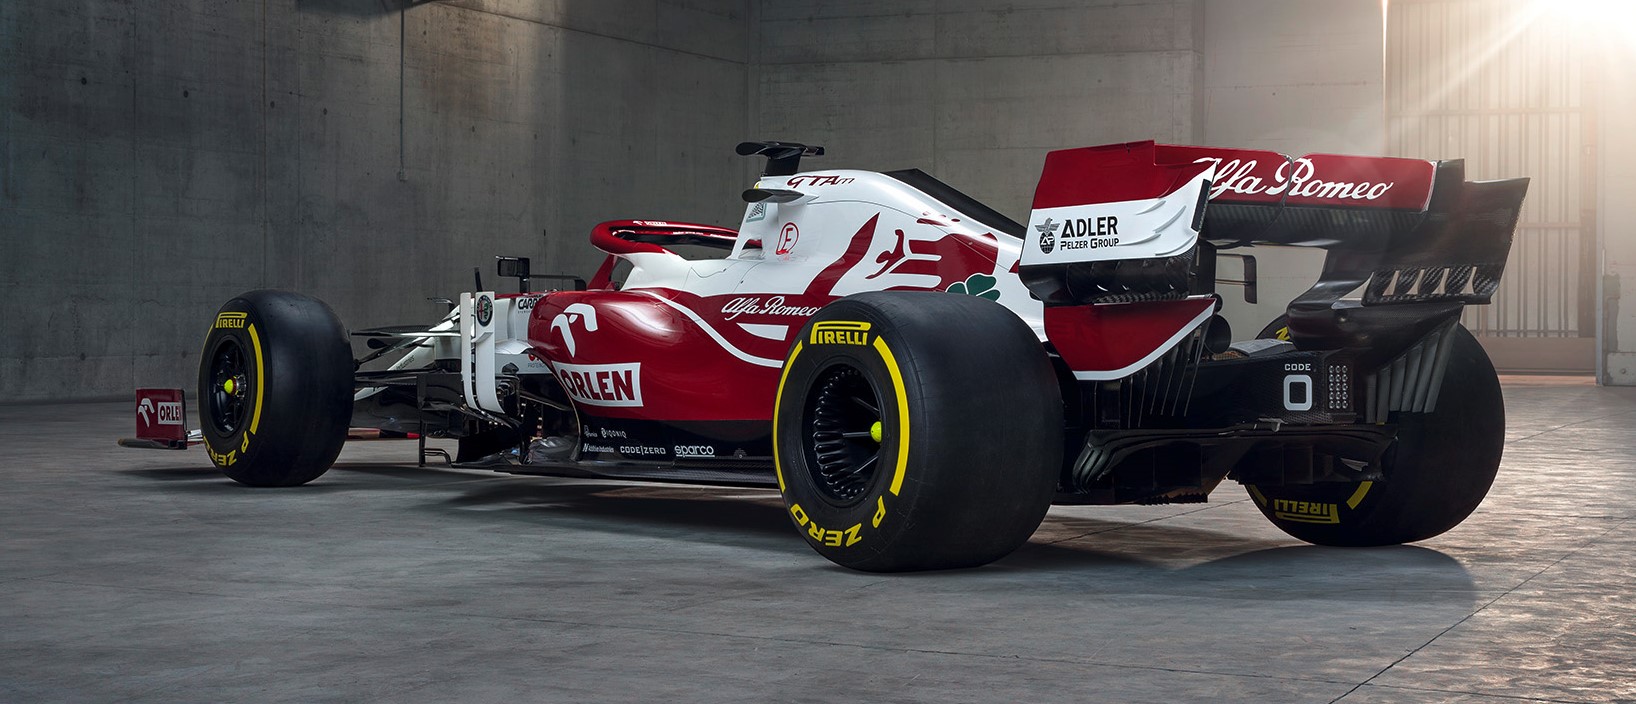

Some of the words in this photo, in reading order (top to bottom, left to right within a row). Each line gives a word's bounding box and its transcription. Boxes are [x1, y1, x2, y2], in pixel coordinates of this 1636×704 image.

[1264, 158, 1394, 200] Romeo
[1060, 216, 1118, 238] ADLER
[215, 312, 248, 328] PIRELLI
[721, 297, 761, 321] Alfa
[760, 296, 823, 316] Romeo
[810, 320, 871, 345] PIRELLI
[1284, 363, 1311, 371] CODE
[560, 369, 636, 401] ORLEN
[160, 405, 182, 421] ORLE
[240, 431, 249, 454] P
[674, 445, 715, 458] sparco
[872, 495, 887, 529] P
[1273, 497, 1341, 524] PIRELLI
[790, 503, 862, 547] ZERO
